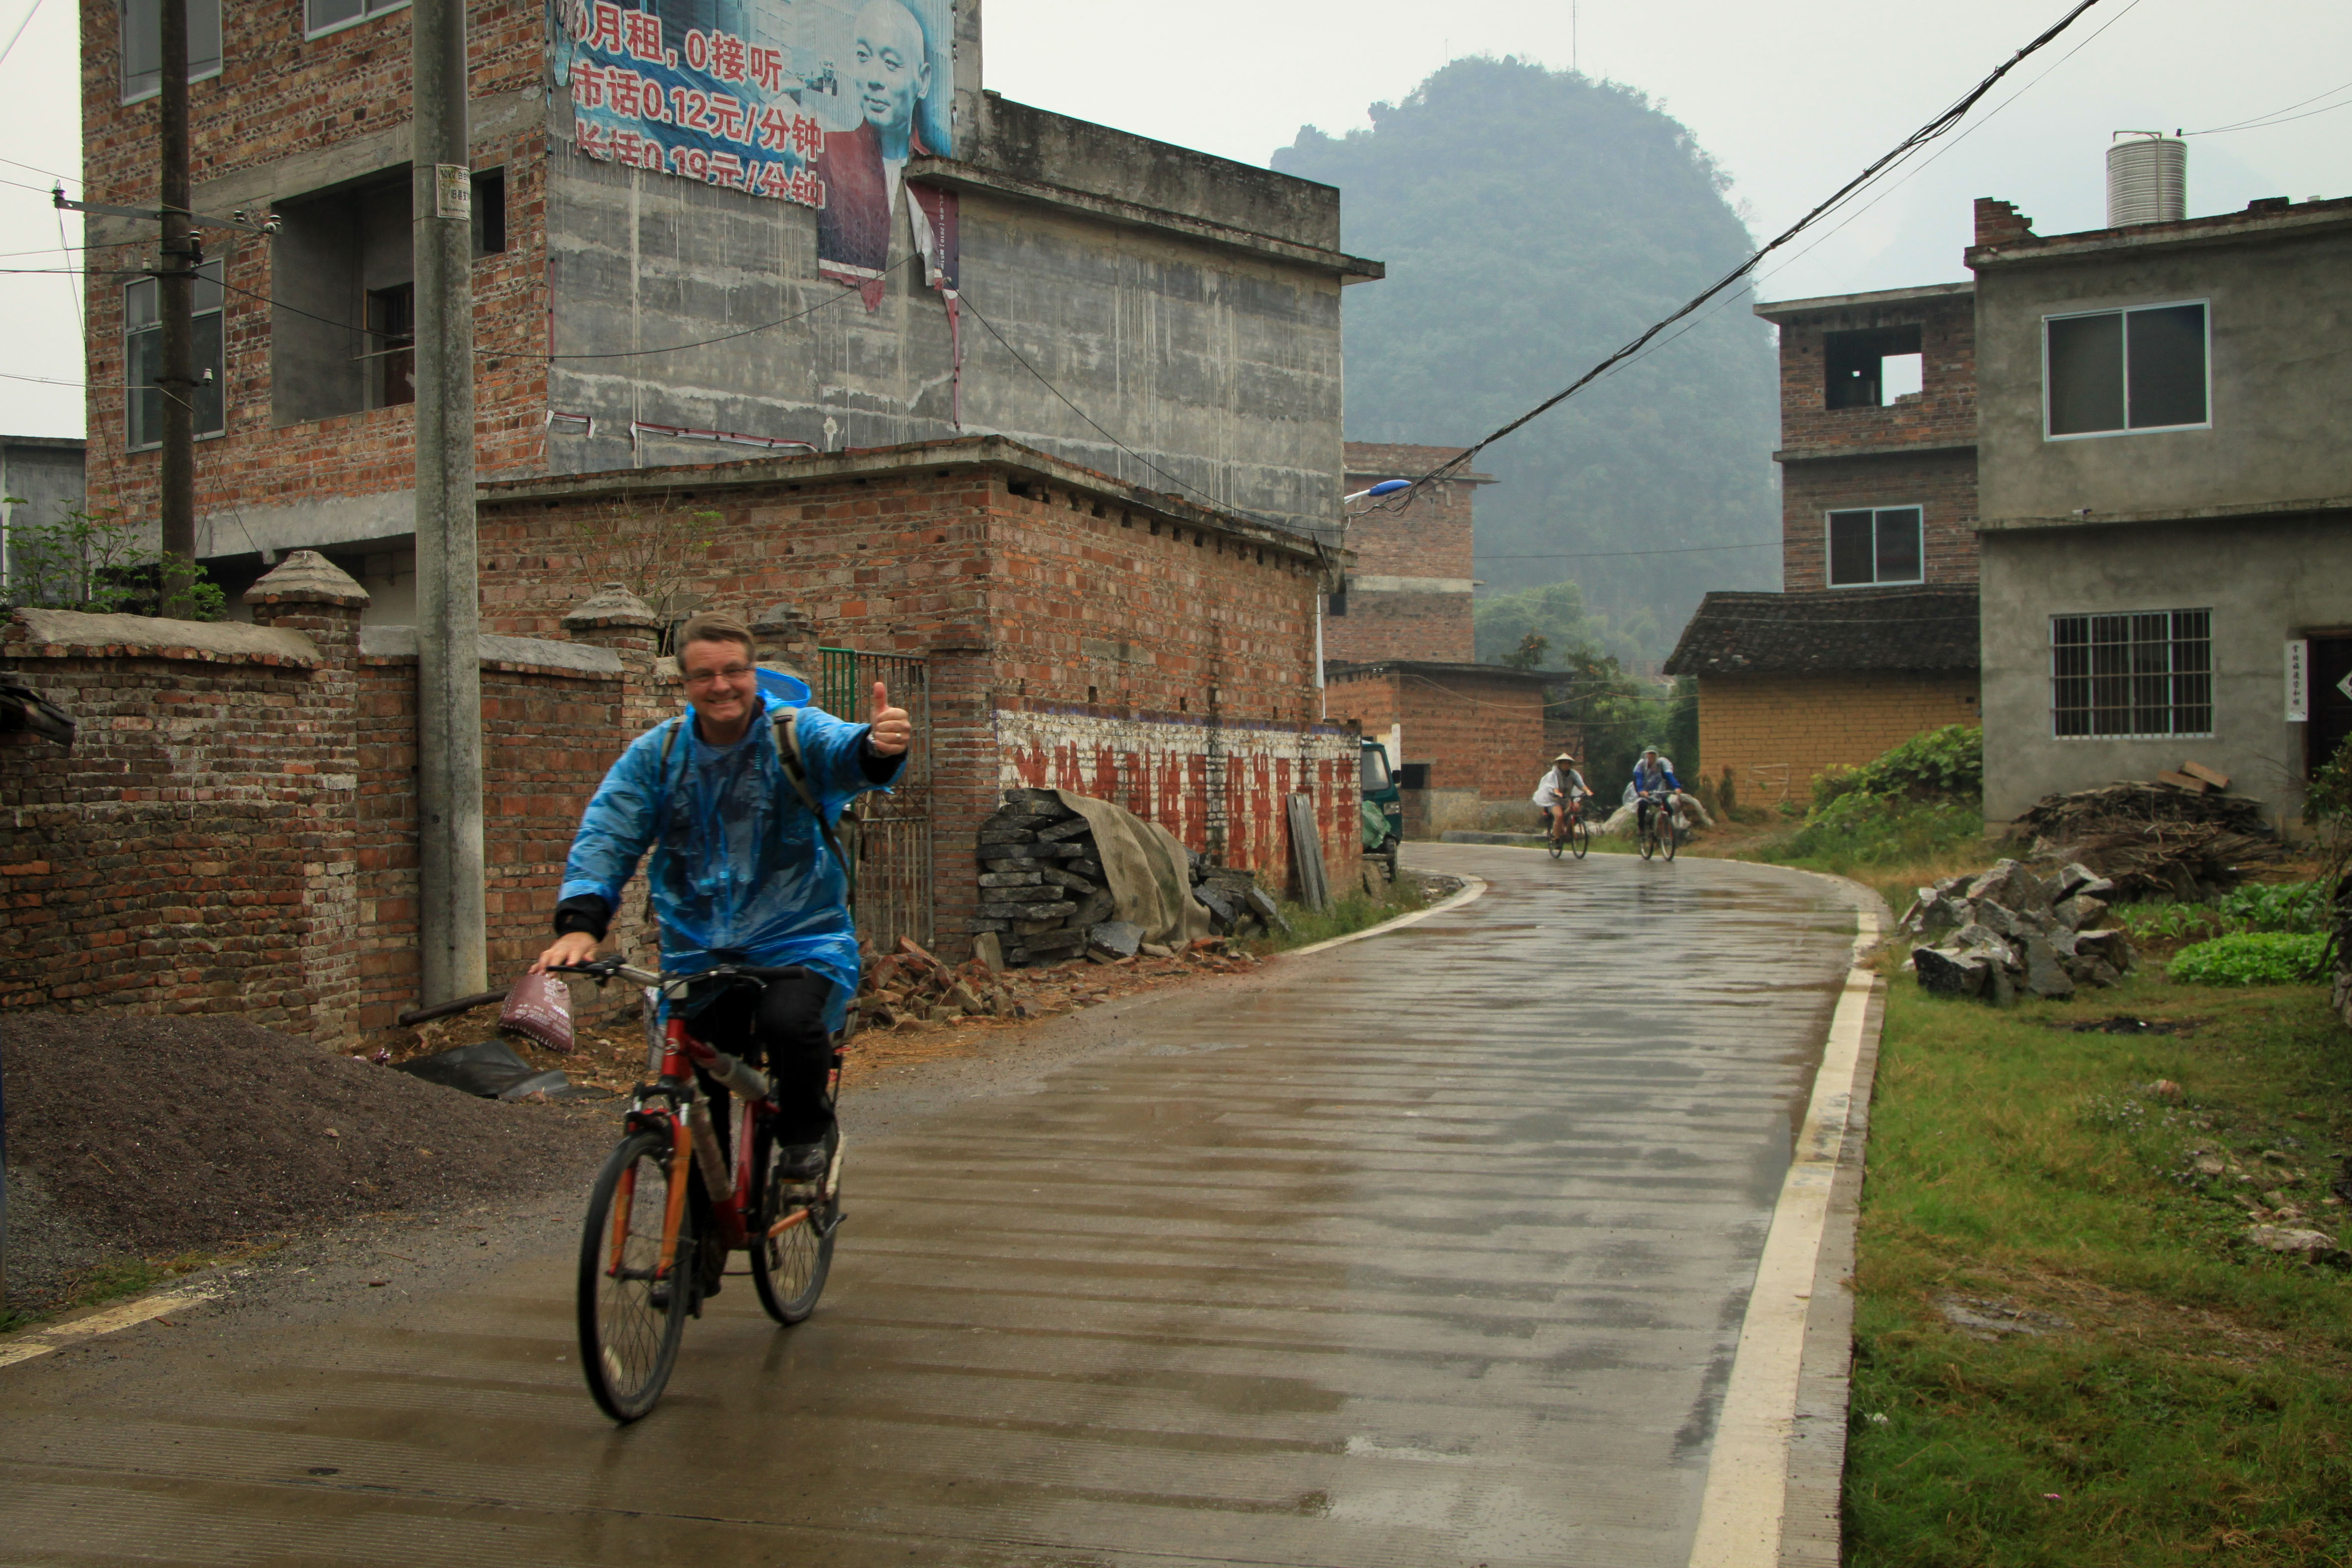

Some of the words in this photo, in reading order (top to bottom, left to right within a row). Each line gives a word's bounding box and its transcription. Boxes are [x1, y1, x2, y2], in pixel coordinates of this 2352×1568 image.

[569, 62, 822, 160] 市话0.12元/分钟
[575, 121, 824, 207] 长话019元/分钟
